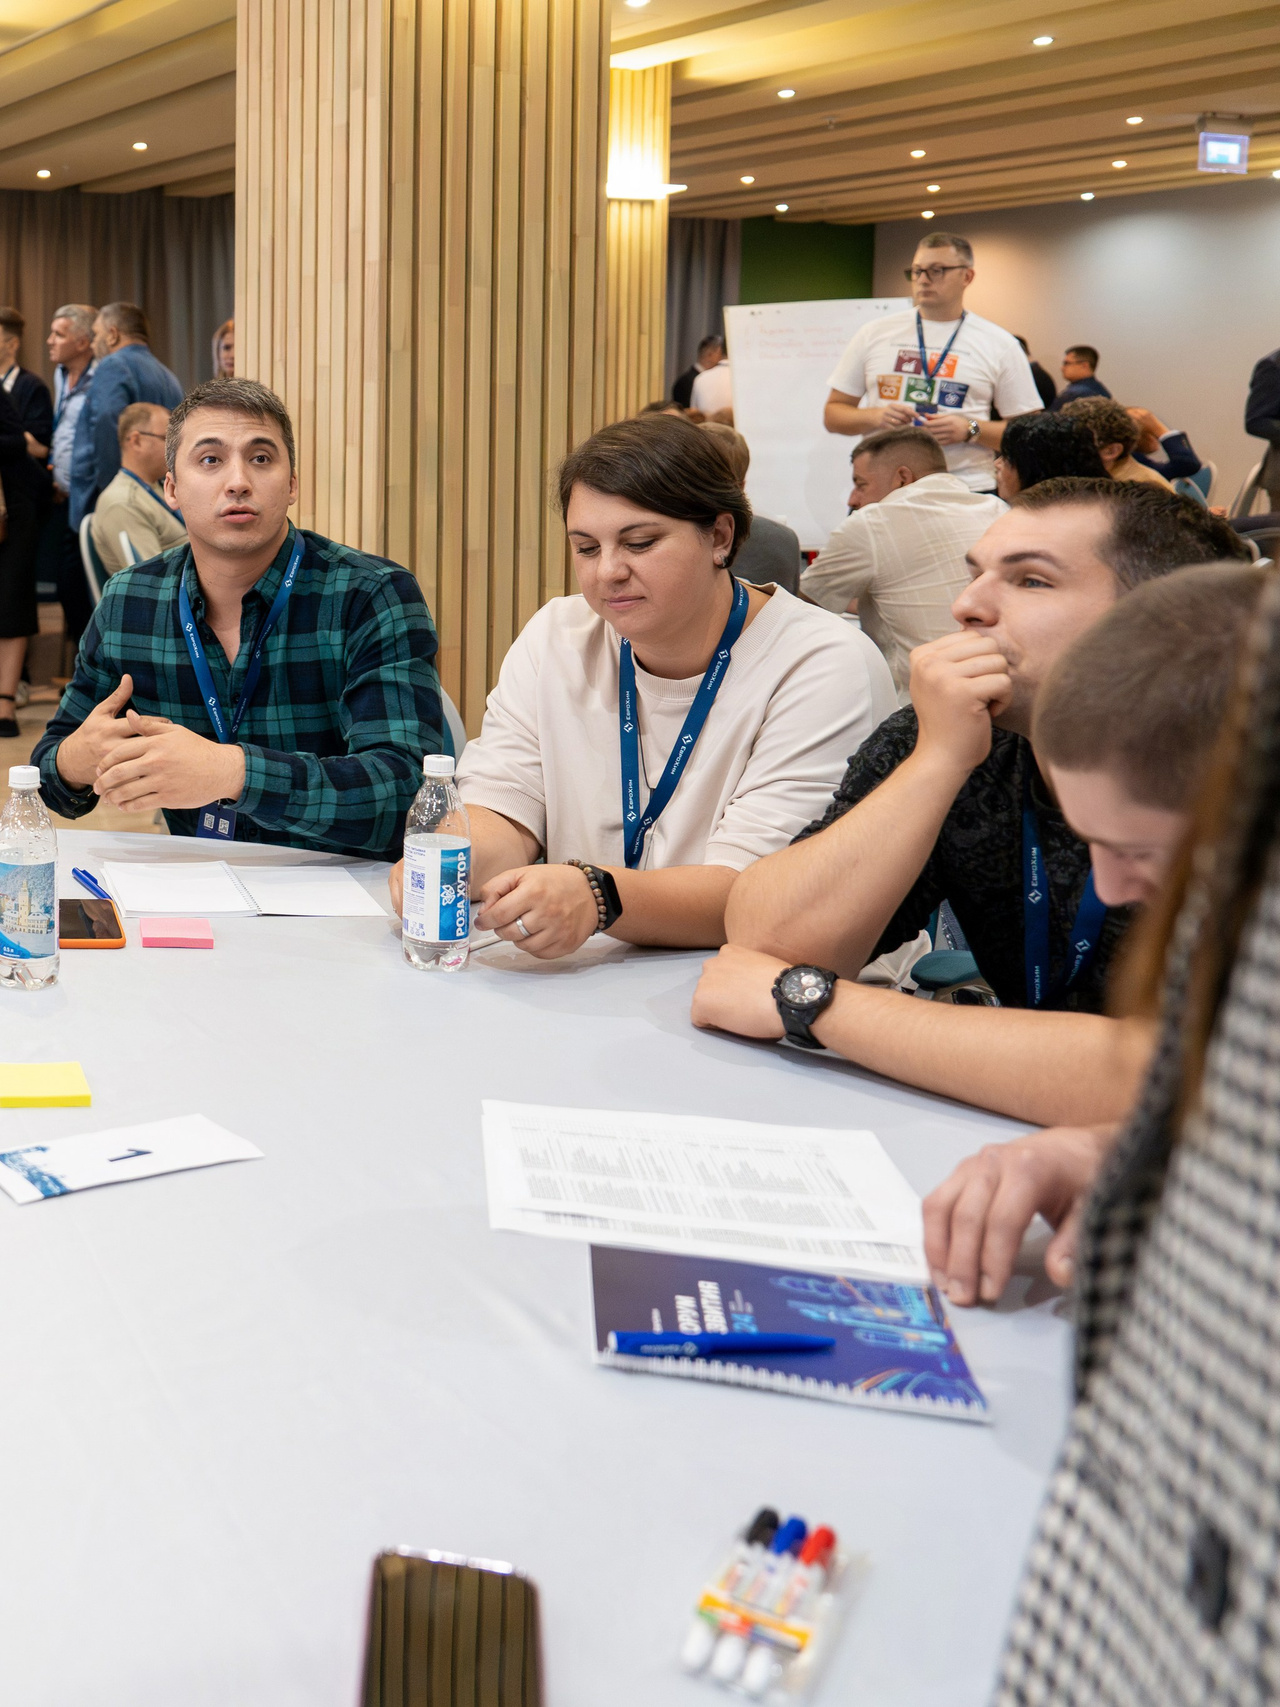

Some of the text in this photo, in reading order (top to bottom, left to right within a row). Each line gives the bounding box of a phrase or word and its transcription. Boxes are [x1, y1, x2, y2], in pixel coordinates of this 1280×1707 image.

[457, 851, 467, 898] ХУТОР
[455, 899, 466, 937] РОЗА
[108, 1148, 153, 1162] 1
[675, 1294, 702, 1336] ОРУМ
[698, 1280, 729, 1336] ЗВИТИЯ
